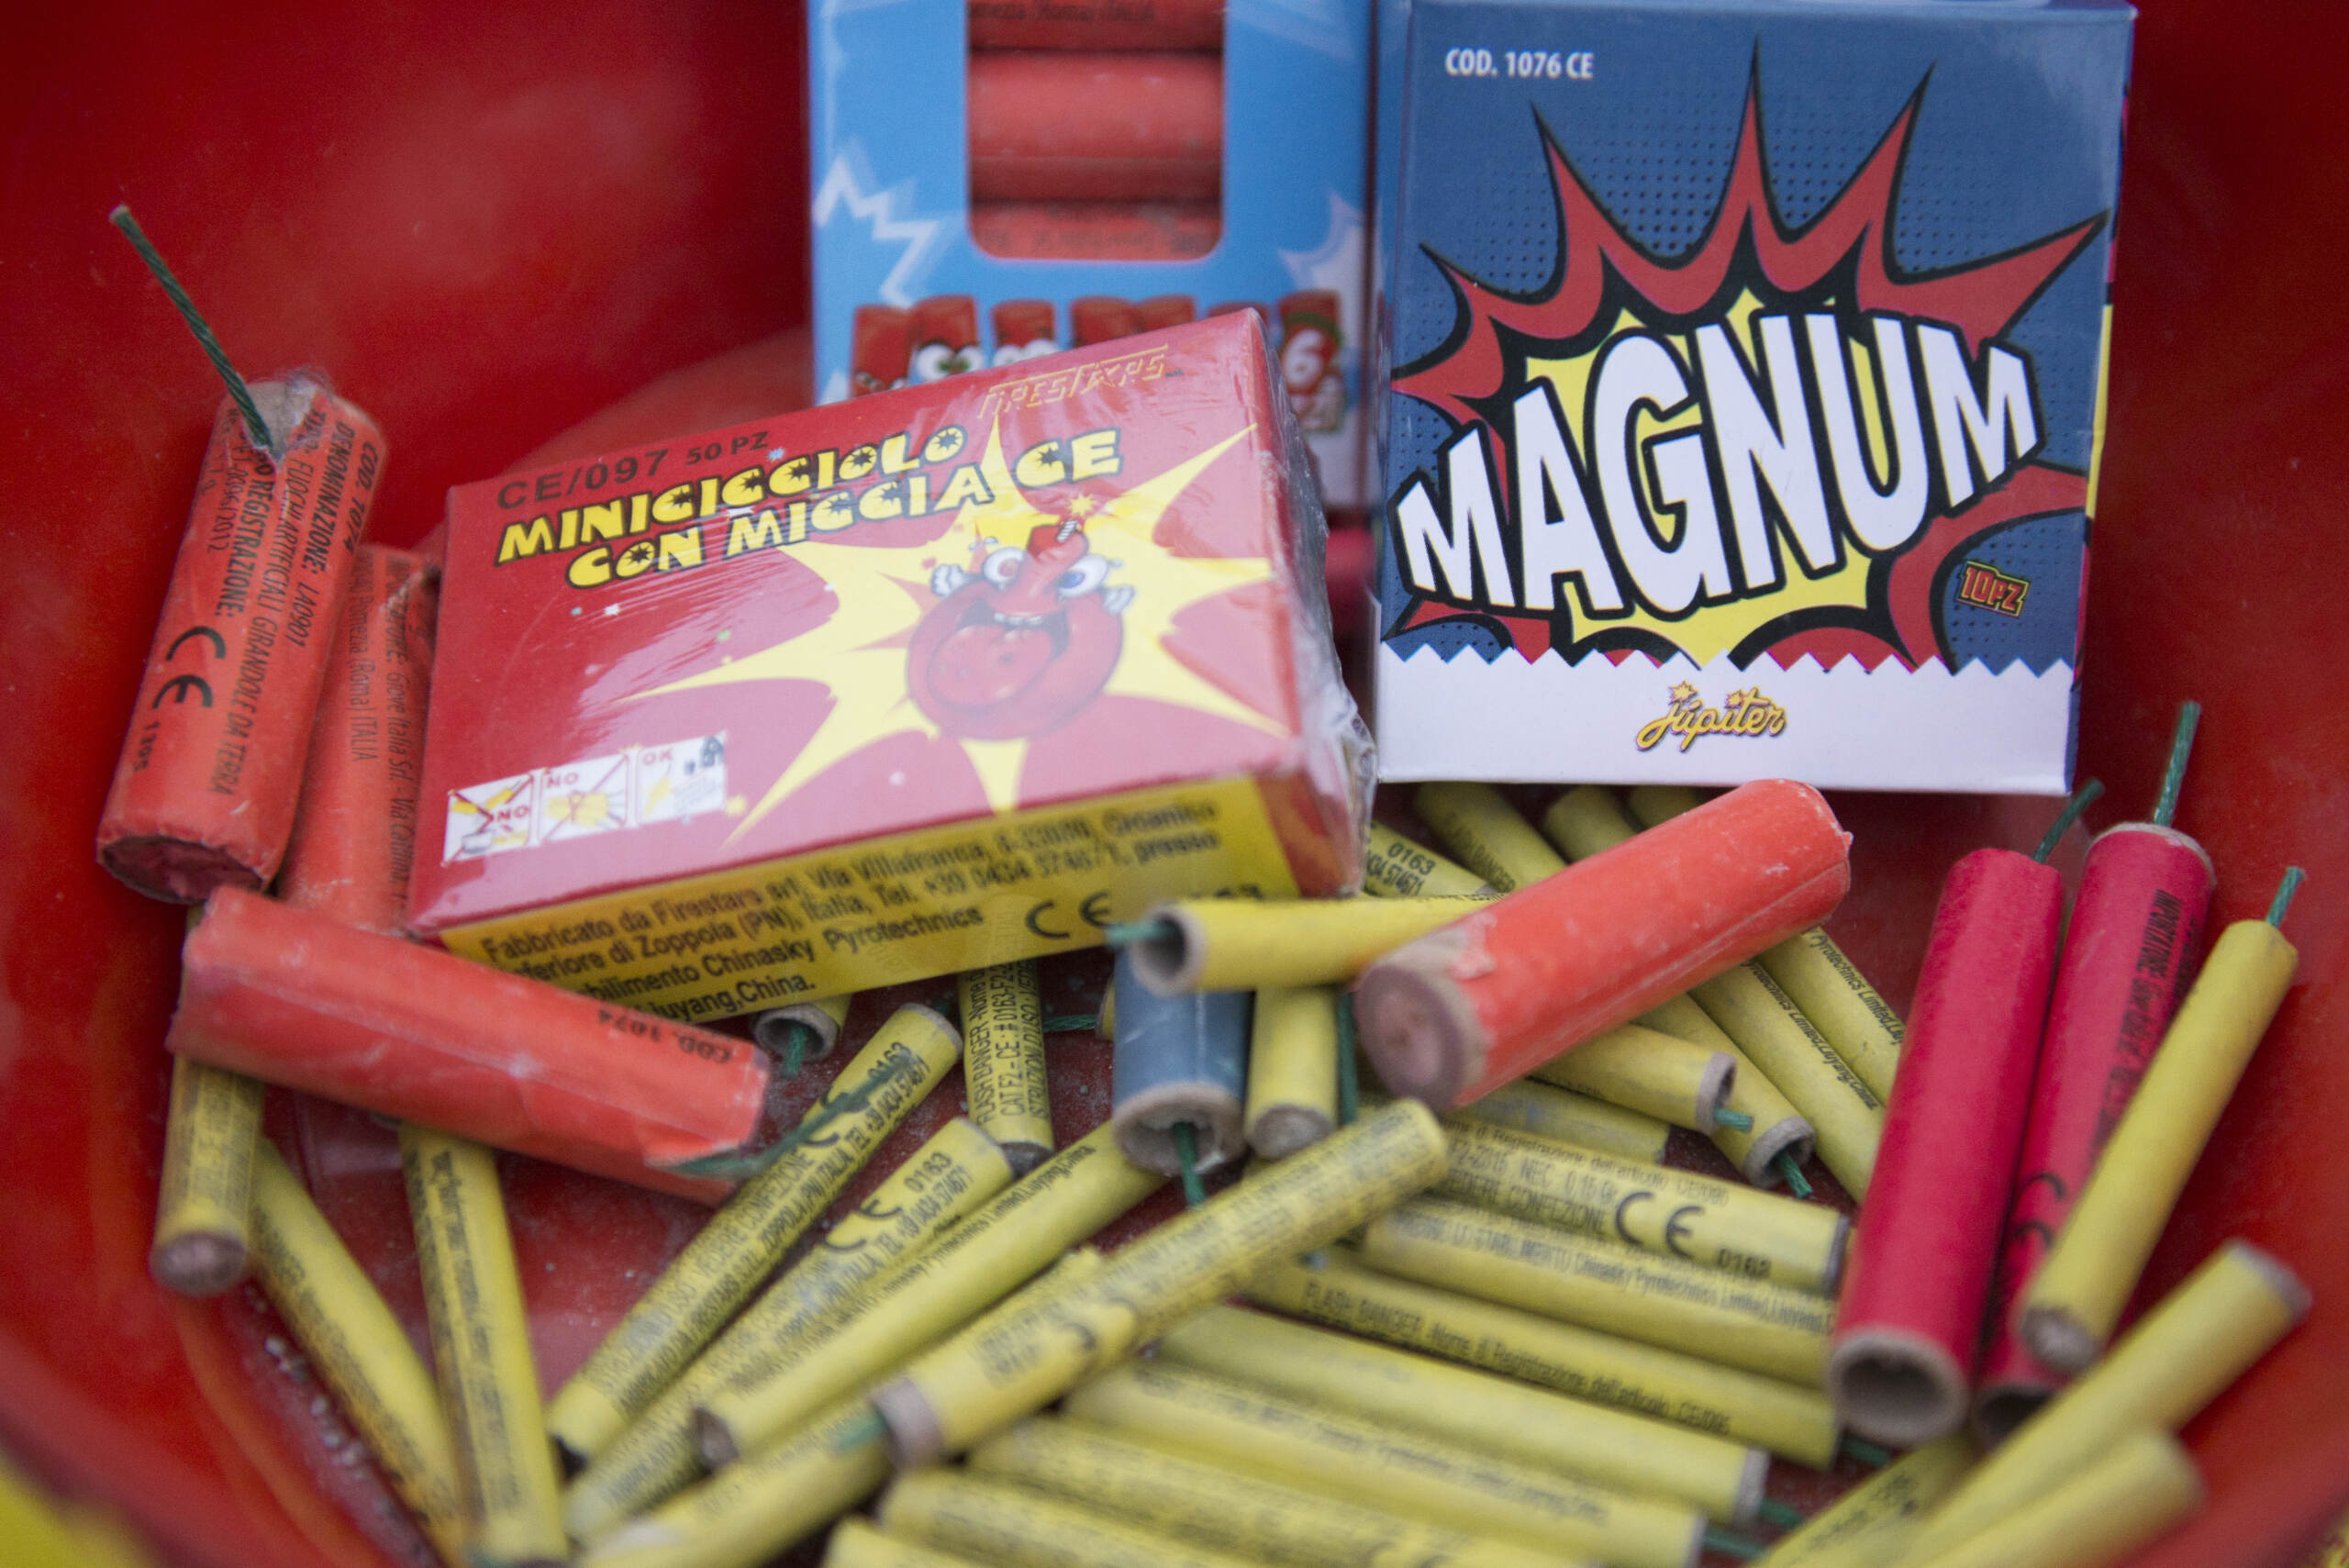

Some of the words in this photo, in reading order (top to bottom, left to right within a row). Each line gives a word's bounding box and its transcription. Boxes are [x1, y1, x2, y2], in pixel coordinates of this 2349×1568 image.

[1445, 49, 1498, 77] COD.
[1506, 50, 1562, 79] 1076
[1566, 53, 1594, 80] CE
[355, 443, 379, 489] COD.
[496, 449, 669, 511] CE/097
[685, 443, 721, 466] 50
[730, 431, 769, 457] PZ
[1396, 312, 2042, 617] MAGNUM
[301, 422, 356, 573] DENOMINAZIONE:
[495, 424, 968, 566] MINICICCIOLO
[566, 526, 706, 589] CON
[727, 460, 996, 558] MICCIA
[1014, 428, 1122, 488] CE
[216, 478, 273, 619] REGISTRAZIONE:
[284, 583, 317, 646] LA0901
[1961, 565, 2028, 615] 10PZ
[154, 626, 226, 710] CE
[230, 616, 277, 713] GIRANDOLE
[225, 716, 252, 738] DA
[350, 717, 377, 762] ITALIA
[211, 740, 245, 795] TERRA
[546, 773, 578, 790] NO
[641, 749, 674, 767] OK
[496, 806, 529, 823] NO
[1386, 840, 1435, 876] 0163
[481, 918, 616, 963] Fabbricato
[619, 910, 650, 934] da
[652, 886, 763, 922] Firestars
[613, 941, 635, 964] di
[640, 921, 735, 960] Zoppola
[584, 963, 700, 1006] bilimento
[702, 938, 815, 983] Chinasky
[822, 904, 985, 956] Pyrotechnics
[1808, 929, 1867, 995] Pyrotechnics
[642, 973, 817, 1023] iuyang,China.
[1741, 957, 1794, 1013] yrotechnics
[903, 1147, 953, 1195] 0163
[1615, 1192, 1707, 1259] CE
